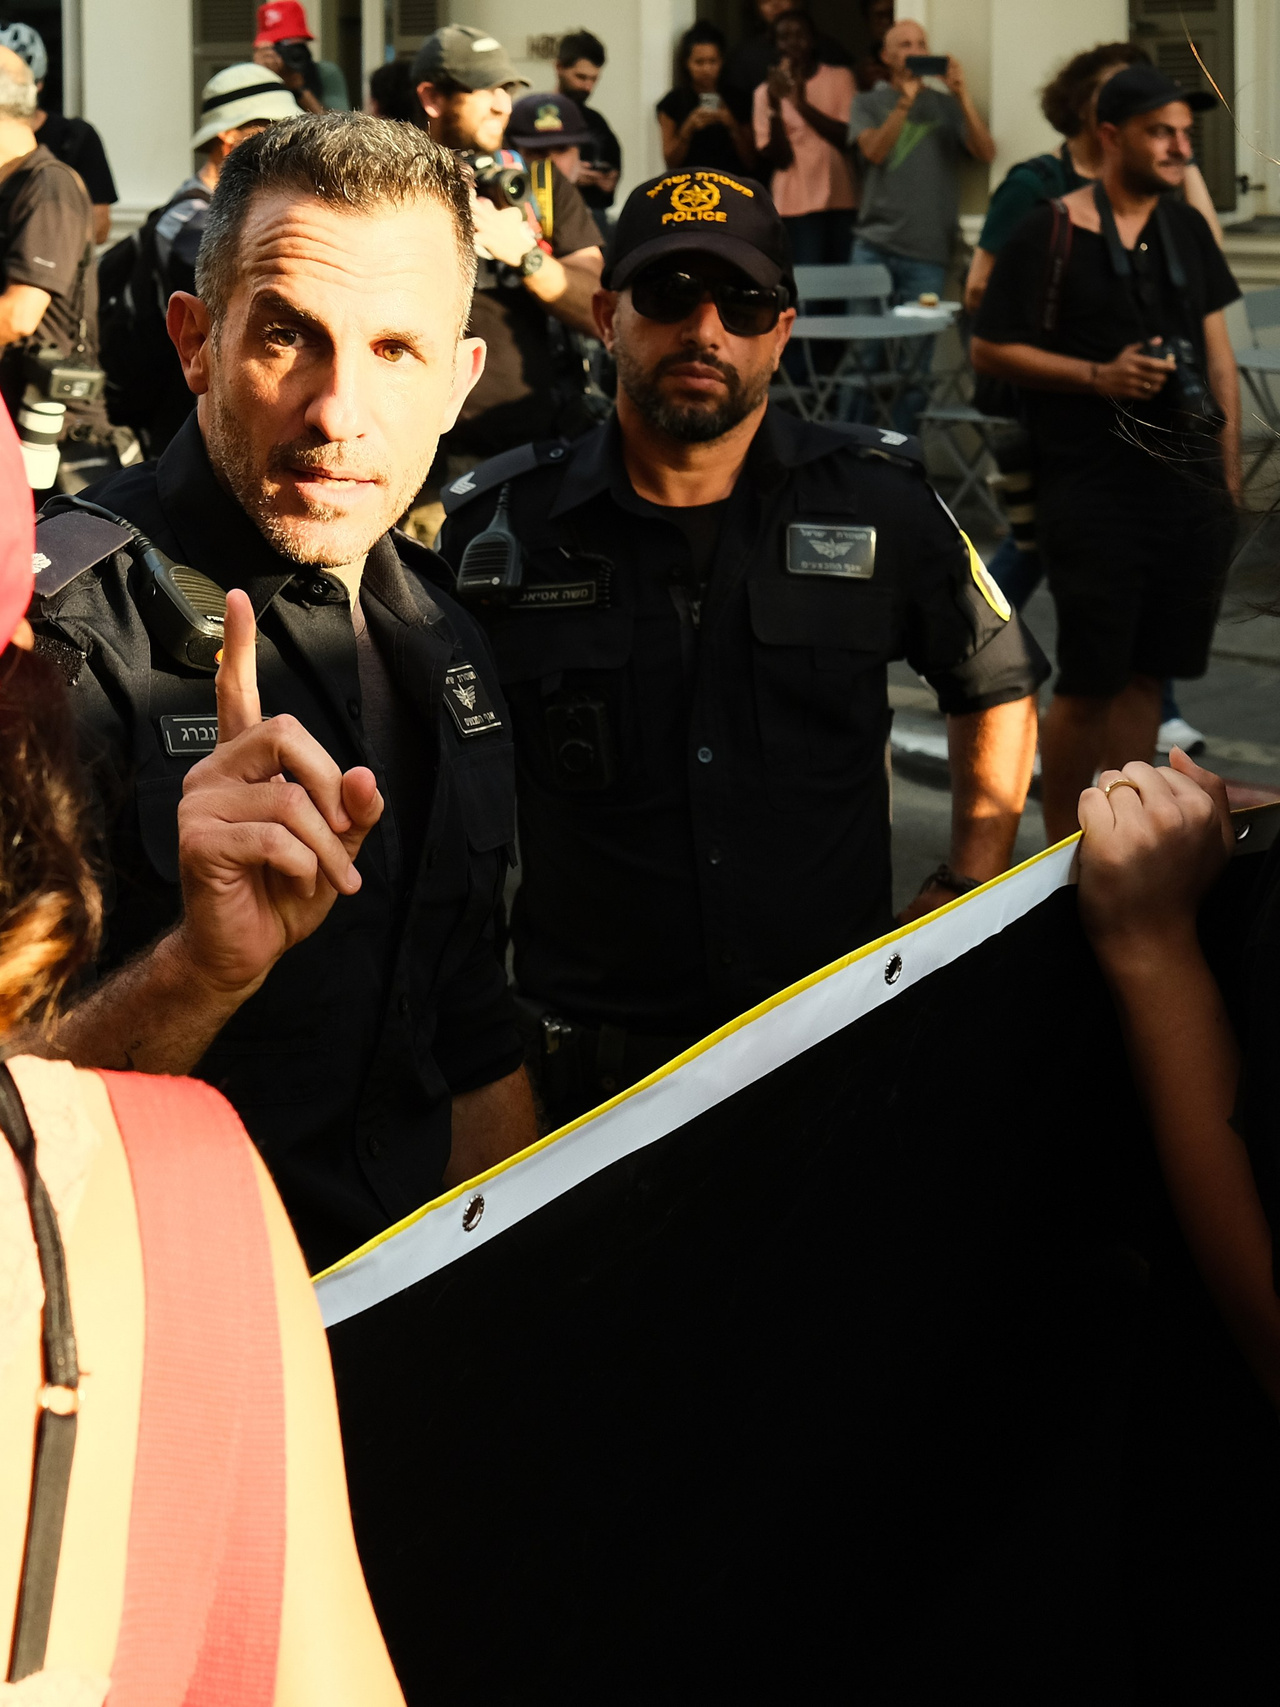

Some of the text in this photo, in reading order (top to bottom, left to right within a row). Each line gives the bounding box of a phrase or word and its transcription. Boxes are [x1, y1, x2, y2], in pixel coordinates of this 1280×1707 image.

[695, 172, 755, 198] משטרת
[661, 210, 728, 225] POLICE
[180, 726, 219, 742] נברג
